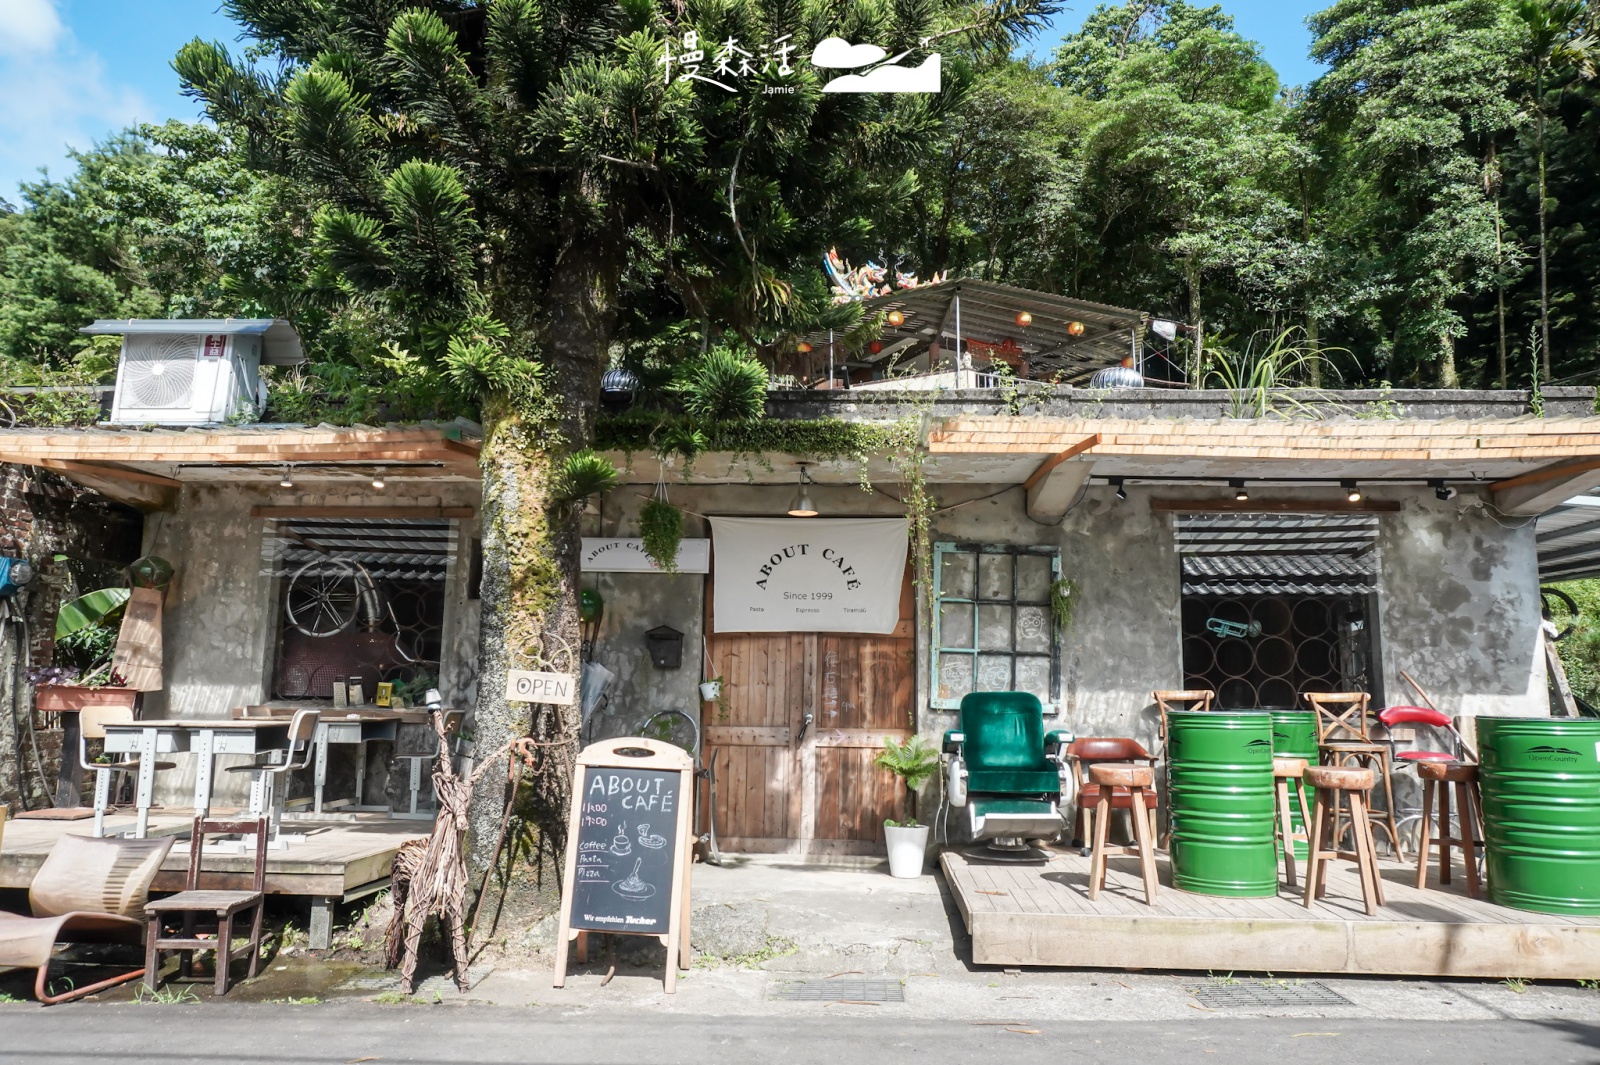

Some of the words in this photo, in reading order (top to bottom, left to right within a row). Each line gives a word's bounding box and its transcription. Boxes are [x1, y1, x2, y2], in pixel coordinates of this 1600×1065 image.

[587, 542, 620, 563] ABOUT
[756, 543, 810, 591] ABOUT
[822, 548, 862, 591] CAFÉ
[783, 592, 808, 601] Since
[811, 592, 834, 601] 1999
[516, 677, 568, 697] OPEN
[1528, 754, 1578, 764] OpenCountry
[589, 774, 665, 797] ABOUT
[621, 790, 673, 812] CAFÉ
[580, 853, 603, 864] Pasta
[577, 867, 601, 878] Pizza
[583, 914, 595, 922] Wir
[595, 915, 624, 925] empfehlen
[625, 915, 657, 926] Tucher
